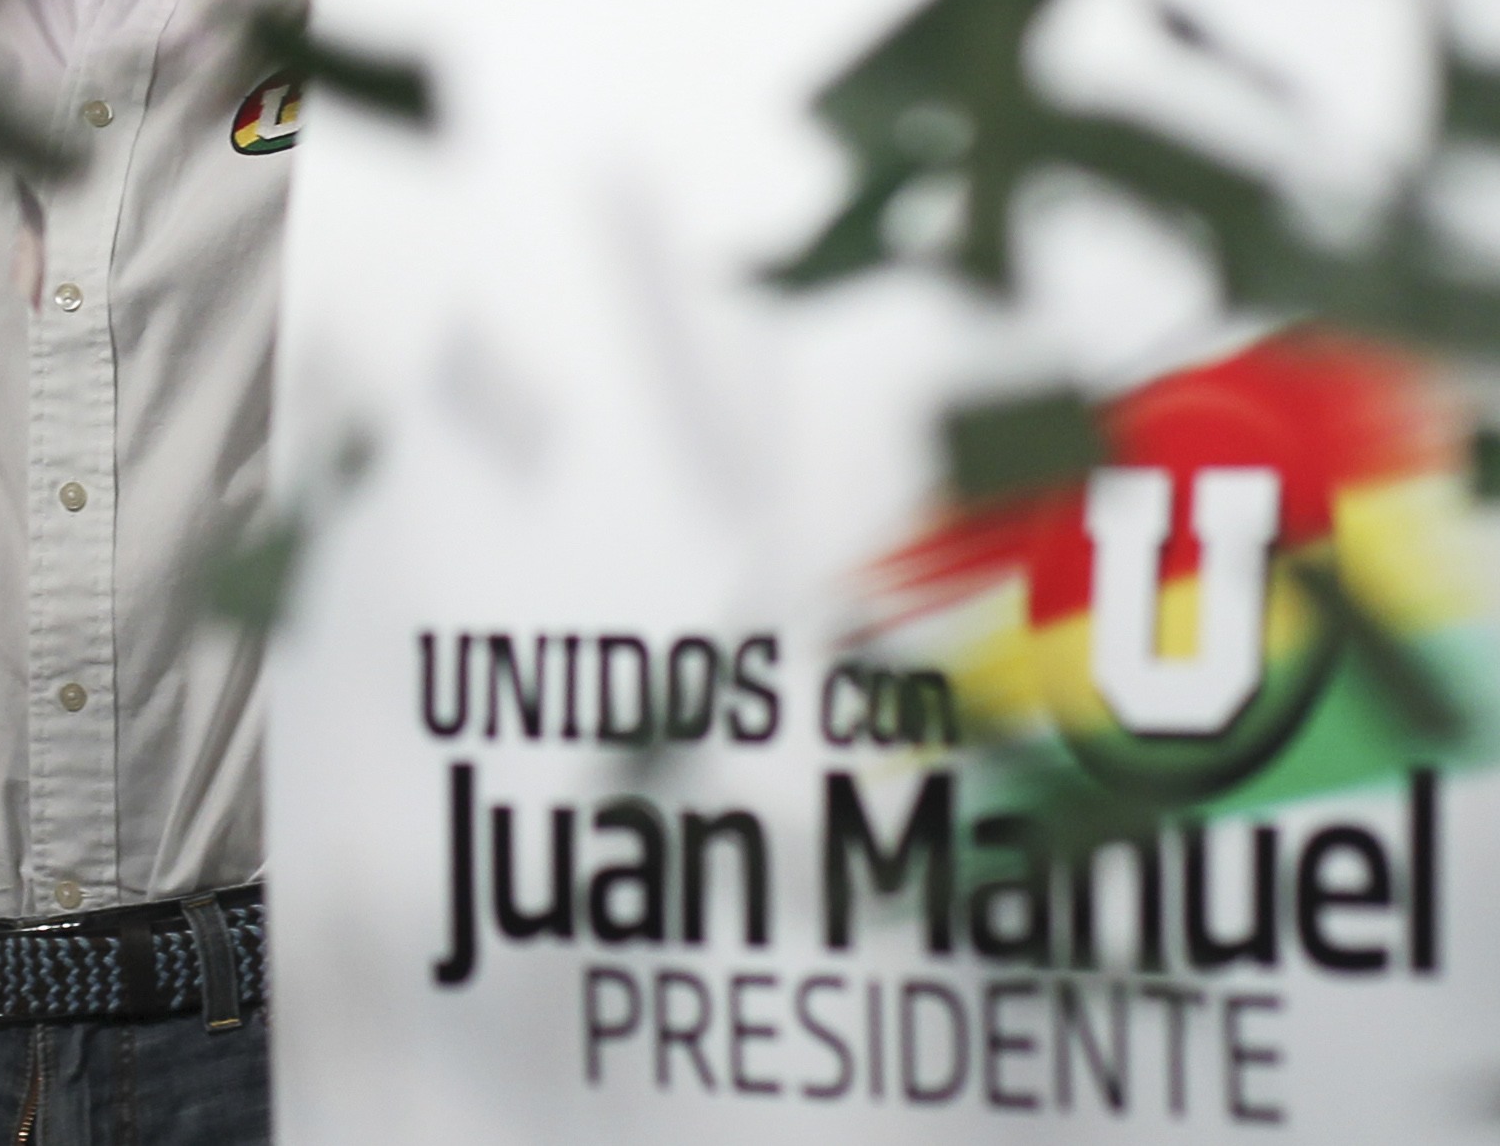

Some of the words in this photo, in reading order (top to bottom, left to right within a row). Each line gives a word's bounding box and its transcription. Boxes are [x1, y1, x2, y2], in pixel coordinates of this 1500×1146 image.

[418, 632, 782, 744] UNIDOS
[821, 662, 958, 746] con
[432, 763, 770, 986] Juan
[821, 765, 1440, 976] Manuel
[584, 964, 1288, 1124] PRESIDENTE
